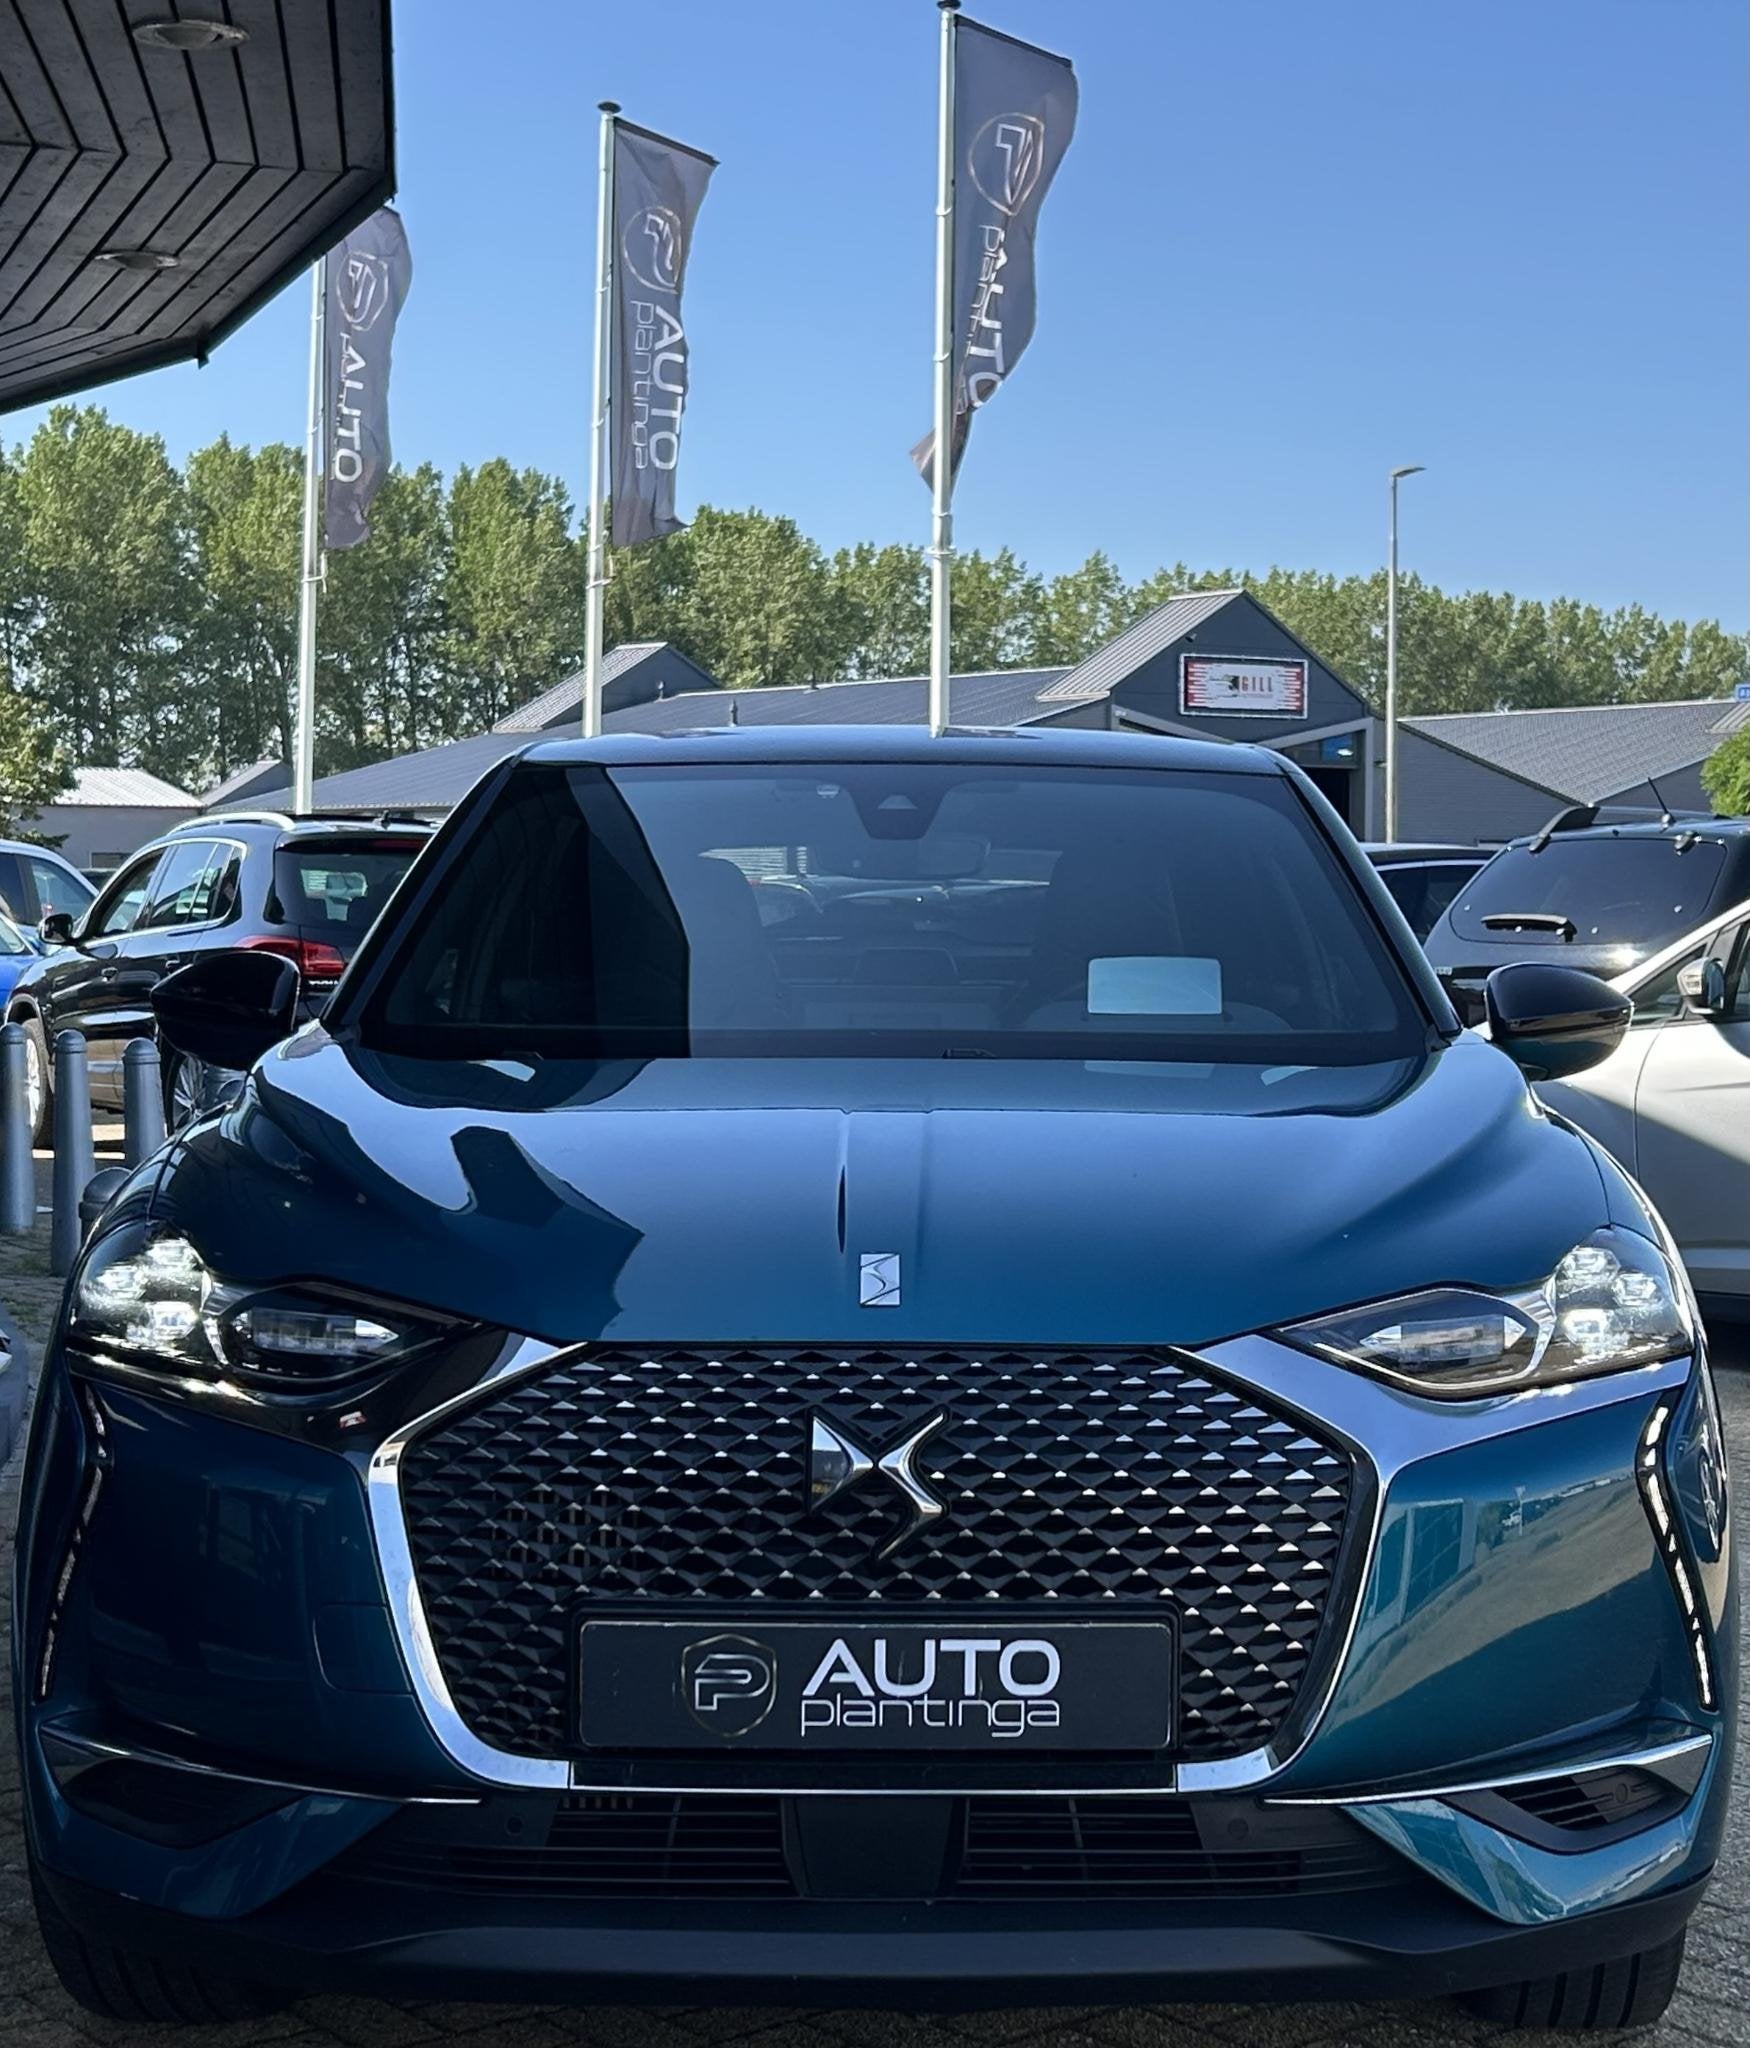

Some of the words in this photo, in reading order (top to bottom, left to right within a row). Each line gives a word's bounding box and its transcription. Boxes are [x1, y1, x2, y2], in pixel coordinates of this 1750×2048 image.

[630, 300, 654, 470] plantinga
[650, 304, 685, 471] AUTO
[801, 1694, 1060, 1737] plantinga
[802, 1638, 1061, 1697] AUTO
